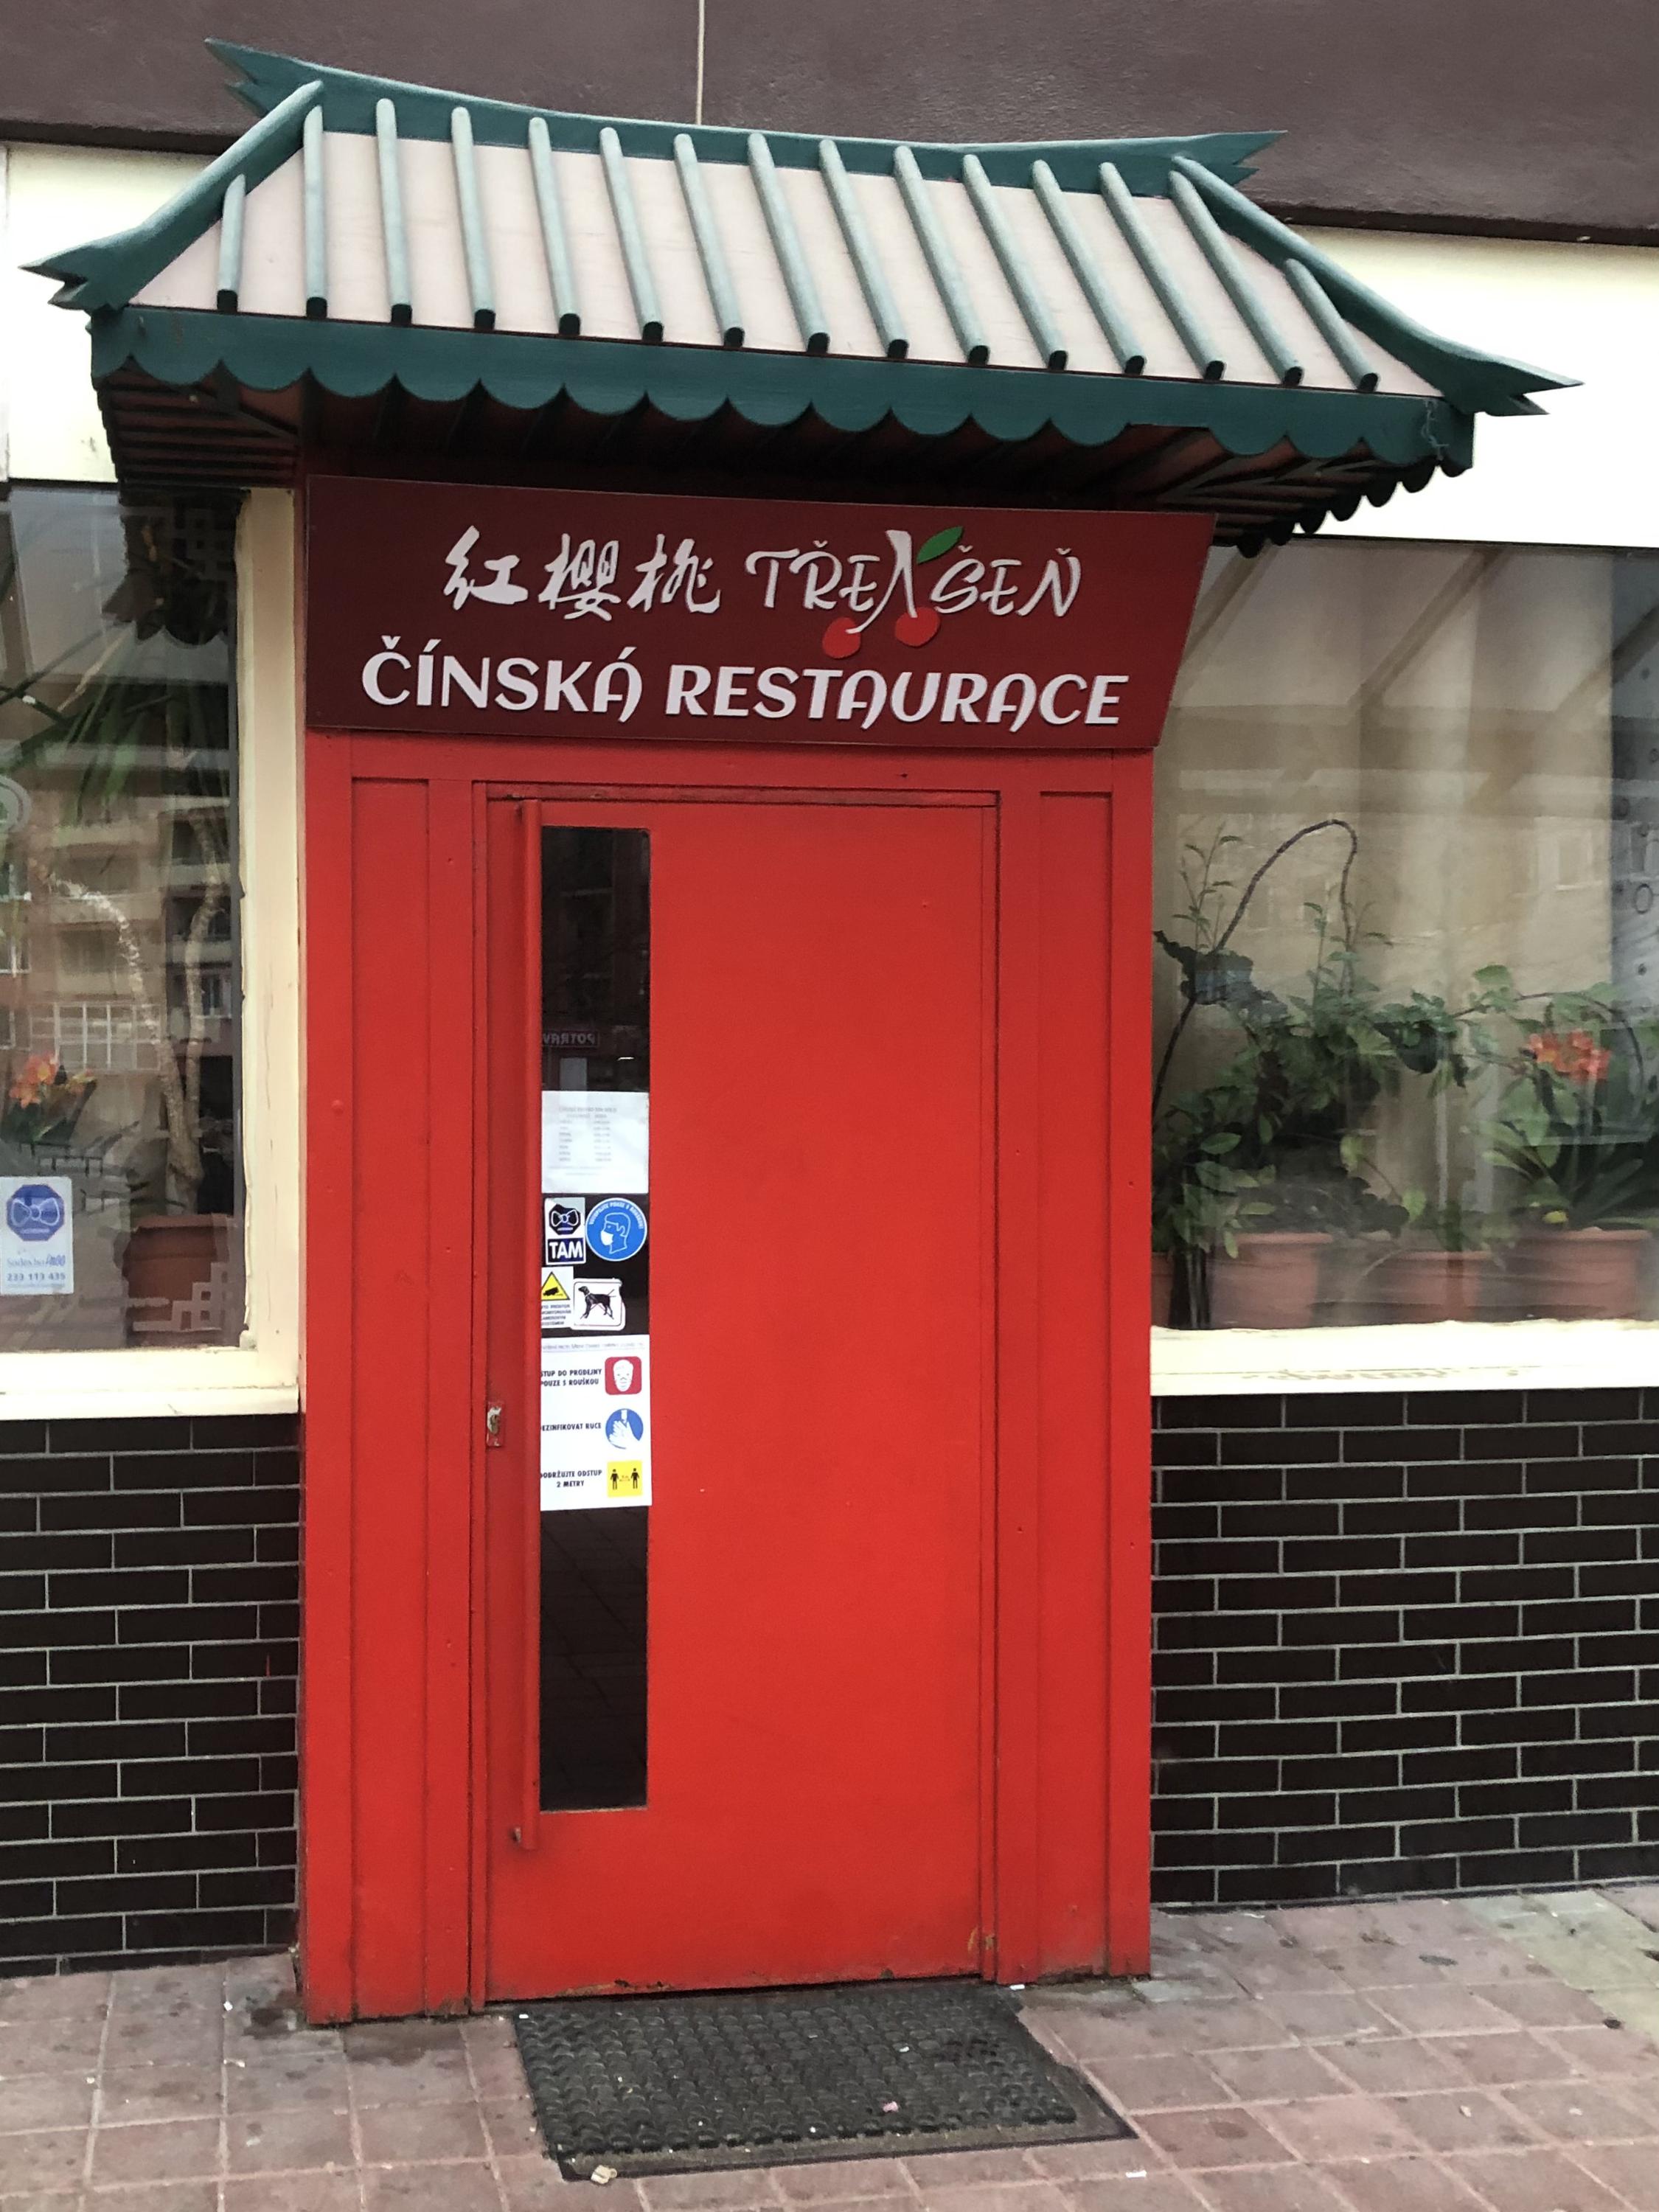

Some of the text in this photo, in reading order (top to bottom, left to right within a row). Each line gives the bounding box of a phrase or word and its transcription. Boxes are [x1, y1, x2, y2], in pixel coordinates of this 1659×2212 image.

[362, 635, 1129, 733] ČÍNSKÁ RESTAURACE
[549, 1241, 583, 1259] TAM
[569, 1368, 602, 1376] PRODEJNY
[568, 1377, 599, 1385] ROUŠKOU
[540, 1423, 583, 1431] EZINFIKOVAT
